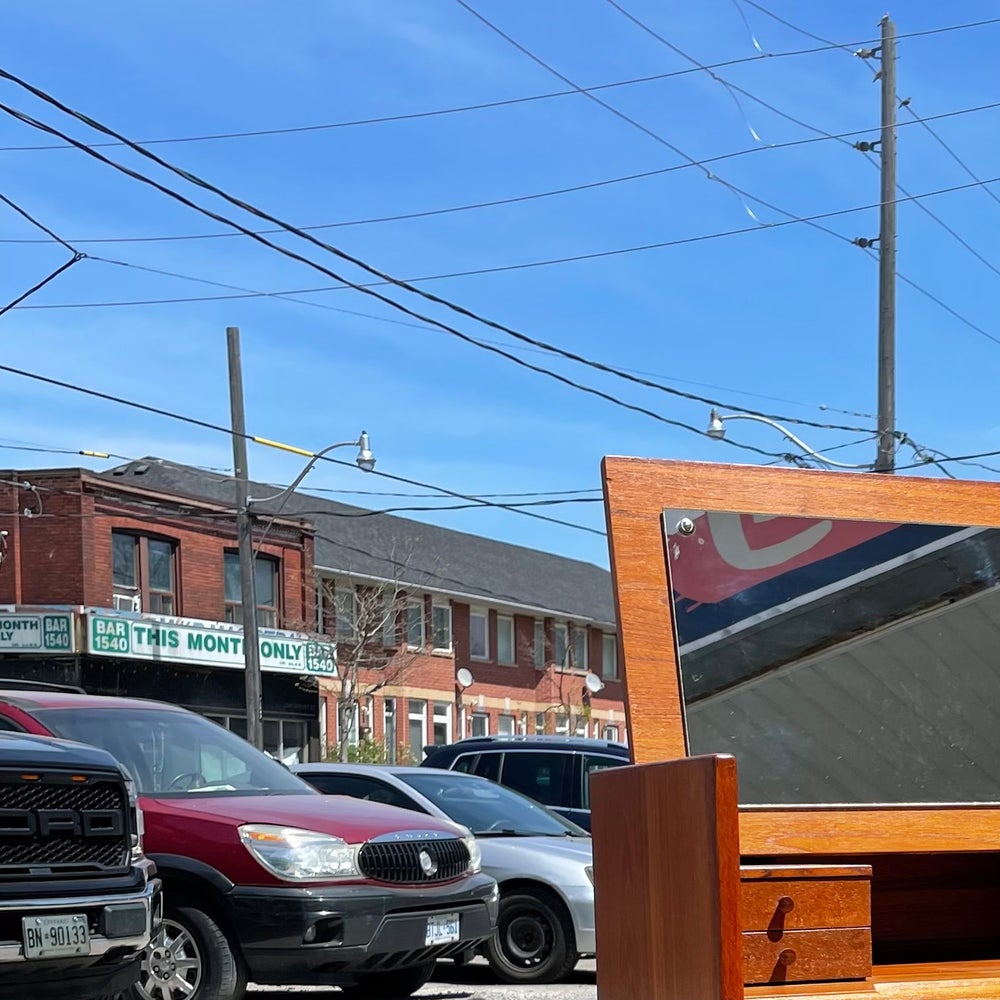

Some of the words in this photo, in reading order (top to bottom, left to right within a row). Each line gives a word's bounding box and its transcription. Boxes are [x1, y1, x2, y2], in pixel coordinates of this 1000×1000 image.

[0, 620, 38, 630] ONTH
[45, 618, 67, 632] BAR
[96, 620, 125, 636] BAR
[1, 631, 14, 641] LY
[44, 633, 69, 647] 1540
[94, 635, 128, 652] 1540
[134, 626, 179, 648] THIS
[261, 641, 302, 661] ONLY
[308, 658, 333, 671] 1540
[0, 808, 124, 836] ORD
[50, 925, 87, 947] 90133
